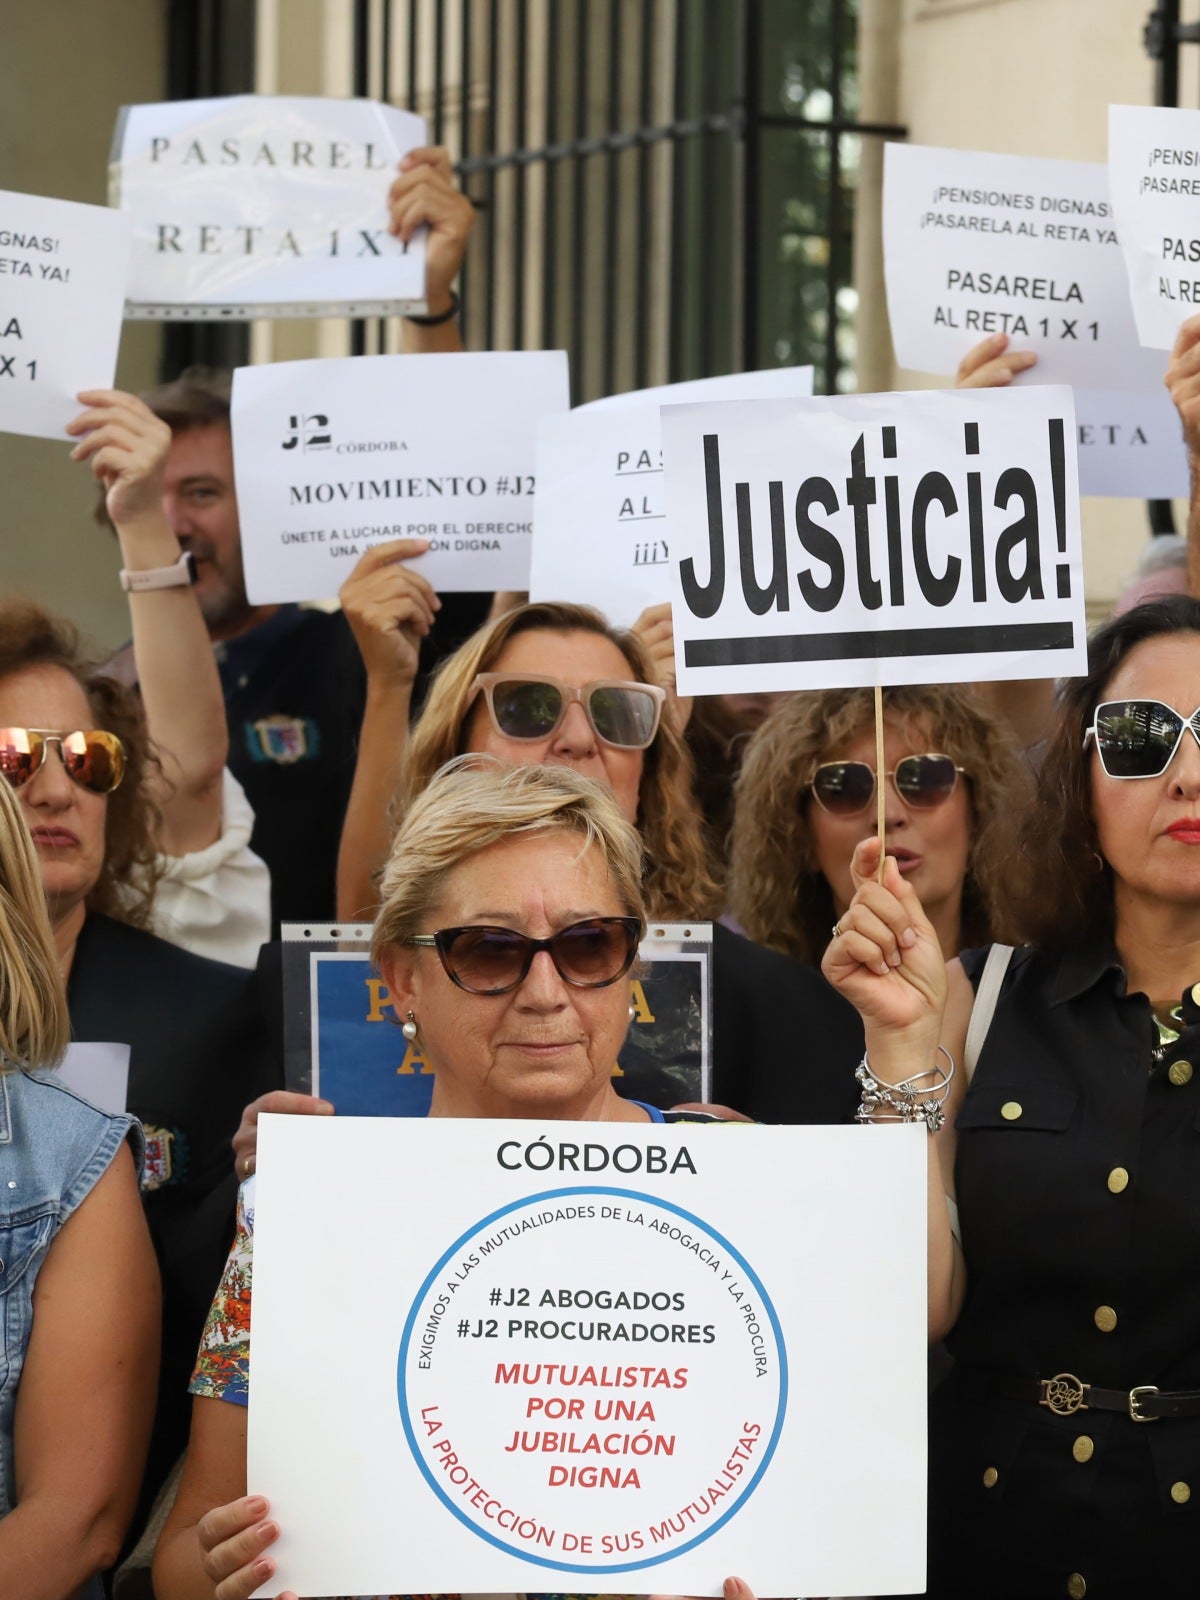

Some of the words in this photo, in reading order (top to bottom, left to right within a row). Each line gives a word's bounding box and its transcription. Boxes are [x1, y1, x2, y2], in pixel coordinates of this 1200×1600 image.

[933, 187, 1034, 209] ¡PENSIONES
[921, 212, 1012, 235] ¡PASARELA
[1016, 222, 1038, 237] AL
[1044, 225, 1090, 242] RETA
[156, 224, 303, 257] RETA
[39, 263, 70, 283] YA!
[947, 270, 1084, 303] PASARELA
[1159, 276, 1176, 300] AL
[934, 306, 959, 328] AL
[965, 310, 1029, 336] RETA
[1040, 318, 1049, 337] 1
[1061, 320, 1078, 340] X
[1089, 322, 1099, 341] 1
[27, 360, 37, 381] 1
[336, 441, 408, 454] CÓRDOBA
[290, 477, 487, 505] MOVIMIENTO
[496, 476, 535, 497] #J2
[619, 496, 652, 517] AL
[679, 418, 1071, 618] Justicia!
[281, 530, 325, 544] ÚNETE
[330, 531, 339, 540] A
[343, 525, 401, 539] LUCHAR
[407, 523, 437, 535] POR
[443, 524, 460, 535] EL
[330, 546, 358, 557] UNA
[455, 540, 500, 551] DIGNA
[496, 1135, 698, 1175] CÓRDOBA
[418, 1293, 451, 1370] EXIGIMOS
[447, 1282, 461, 1294] A
[454, 1253, 481, 1281] LAS
[478, 1205, 596, 1257] MUTUALIDADES
[601, 1206, 622, 1221] DE
[626, 1210, 645, 1226] LA
[647, 1218, 721, 1273] ABOGACIA
[720, 1269, 733, 1281] Y
[727, 1281, 745, 1303] LA
[739, 1303, 768, 1378] PROCURA
[489, 1287, 530, 1307] #J2
[538, 1289, 685, 1311] ABOGADOS
[457, 1319, 499, 1339] #J2
[508, 1320, 716, 1344] PROCURADORES
[494, 1363, 688, 1389] MUTUALISTAS
[526, 1397, 584, 1420] POR
[594, 1399, 656, 1421] UNA
[504, 1429, 676, 1456] JUBILACIÓN
[421, 1405, 443, 1437] LA
[432, 1439, 556, 1547] PROTECCIÓN
[561, 1533, 593, 1554] DE
[601, 1530, 645, 1554] SUS
[648, 1421, 761, 1543] MUTUALISTAS
[548, 1465, 641, 1489] DIGNA
